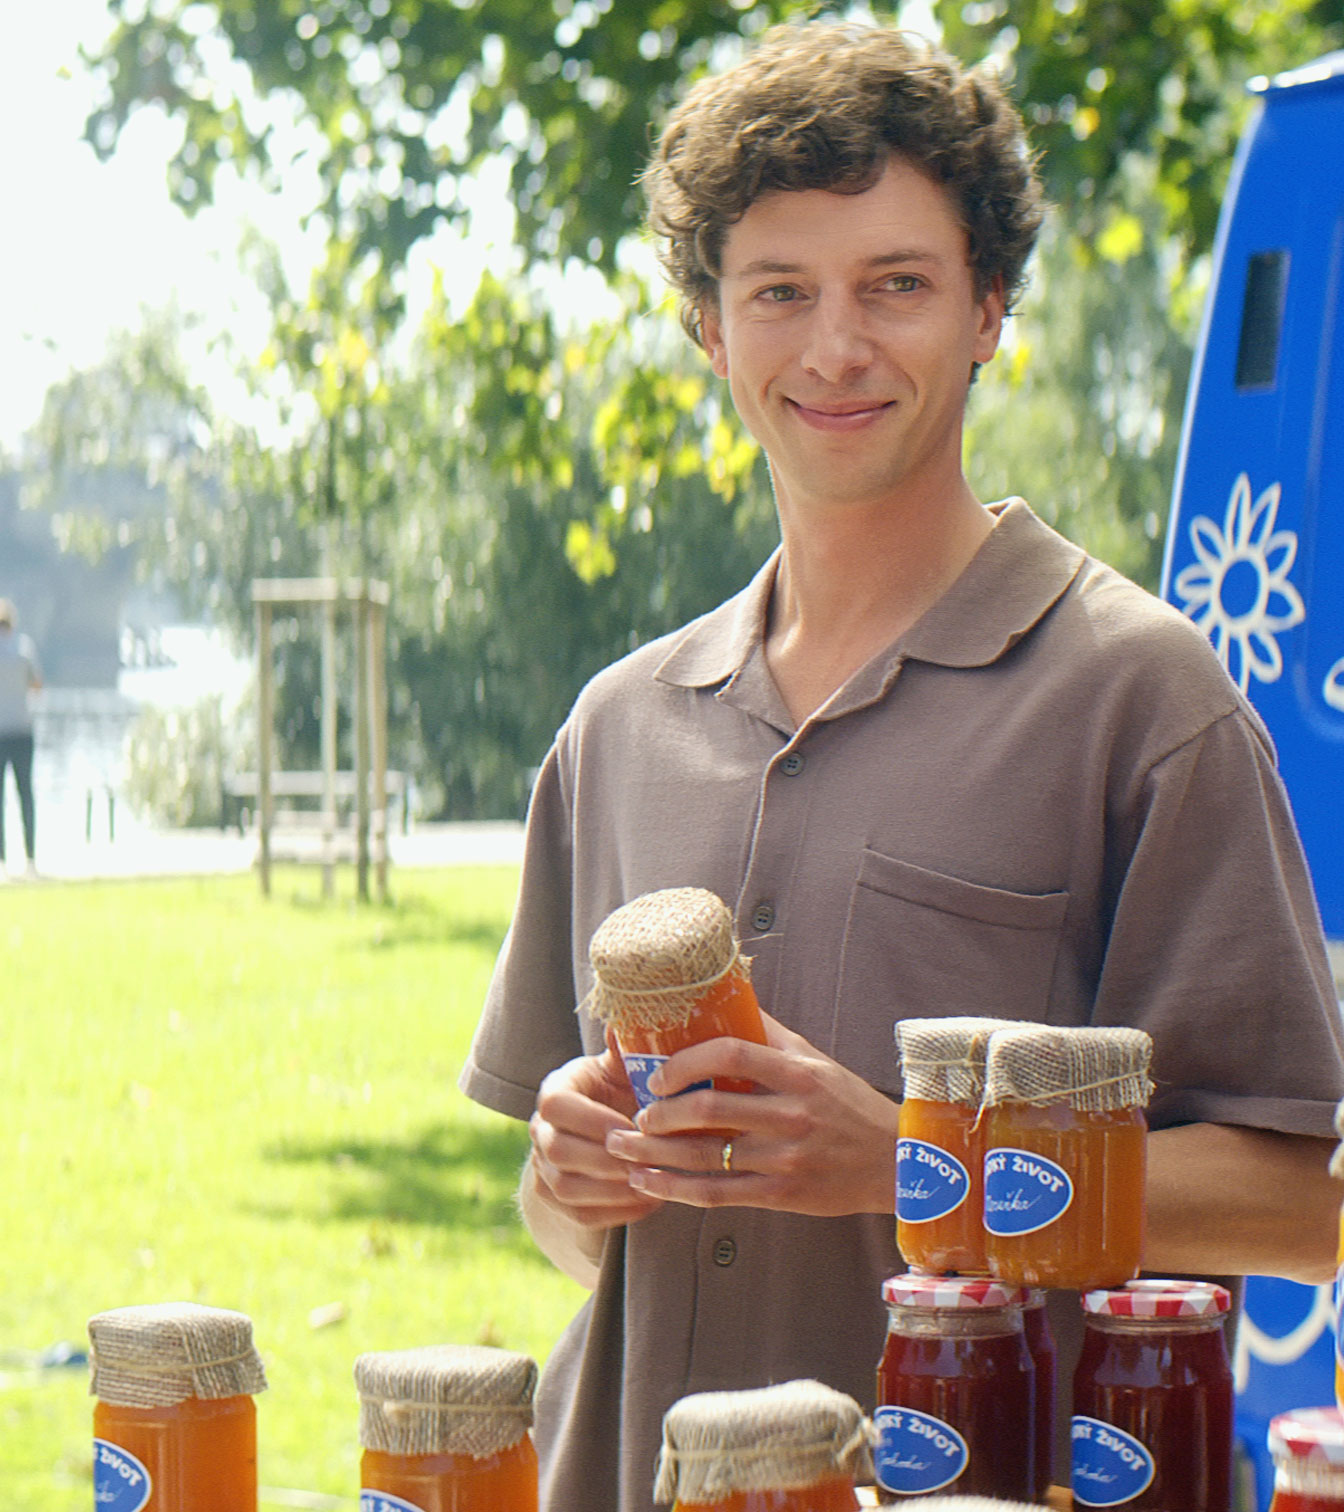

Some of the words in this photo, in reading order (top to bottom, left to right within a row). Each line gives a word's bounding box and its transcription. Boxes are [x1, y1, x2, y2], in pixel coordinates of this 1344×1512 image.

[915, 1146, 963, 1185] ŽIVOT
[1012, 1155, 1065, 1193] ŽIVOT
[907, 1416, 960, 1457] ŽIVOT
[1095, 1428, 1147, 1471] ŽIVOT
